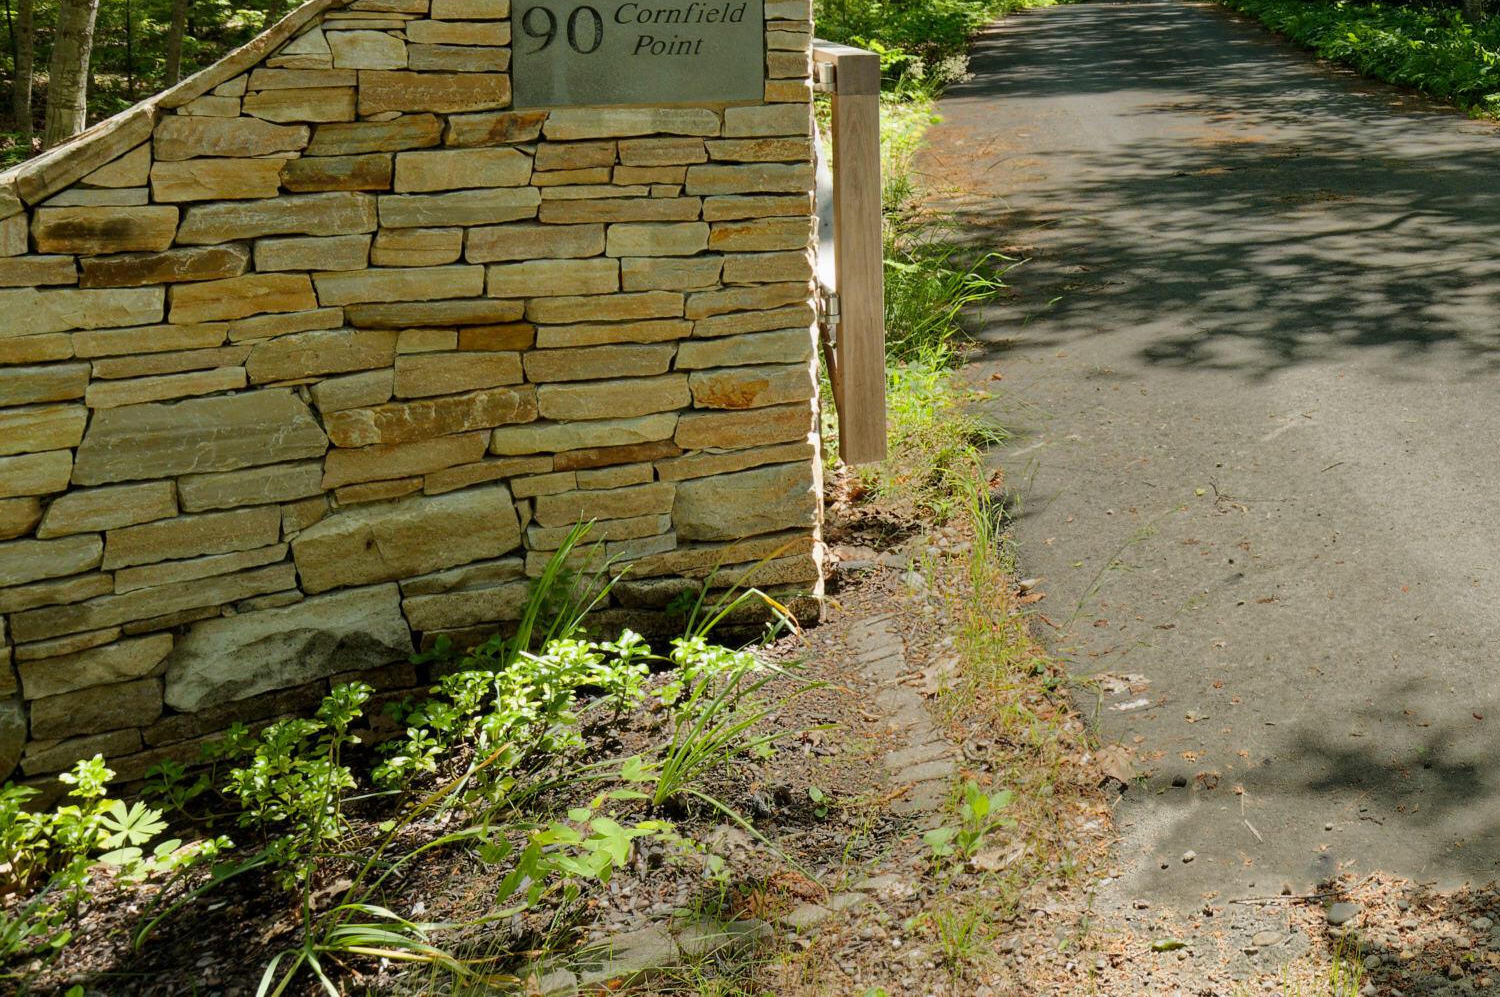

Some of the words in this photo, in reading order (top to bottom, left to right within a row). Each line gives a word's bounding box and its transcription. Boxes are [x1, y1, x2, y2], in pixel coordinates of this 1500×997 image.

[614, 2, 748, 25] Cornfield
[521, 5, 604, 55] 90
[632, 34, 705, 56] Point
